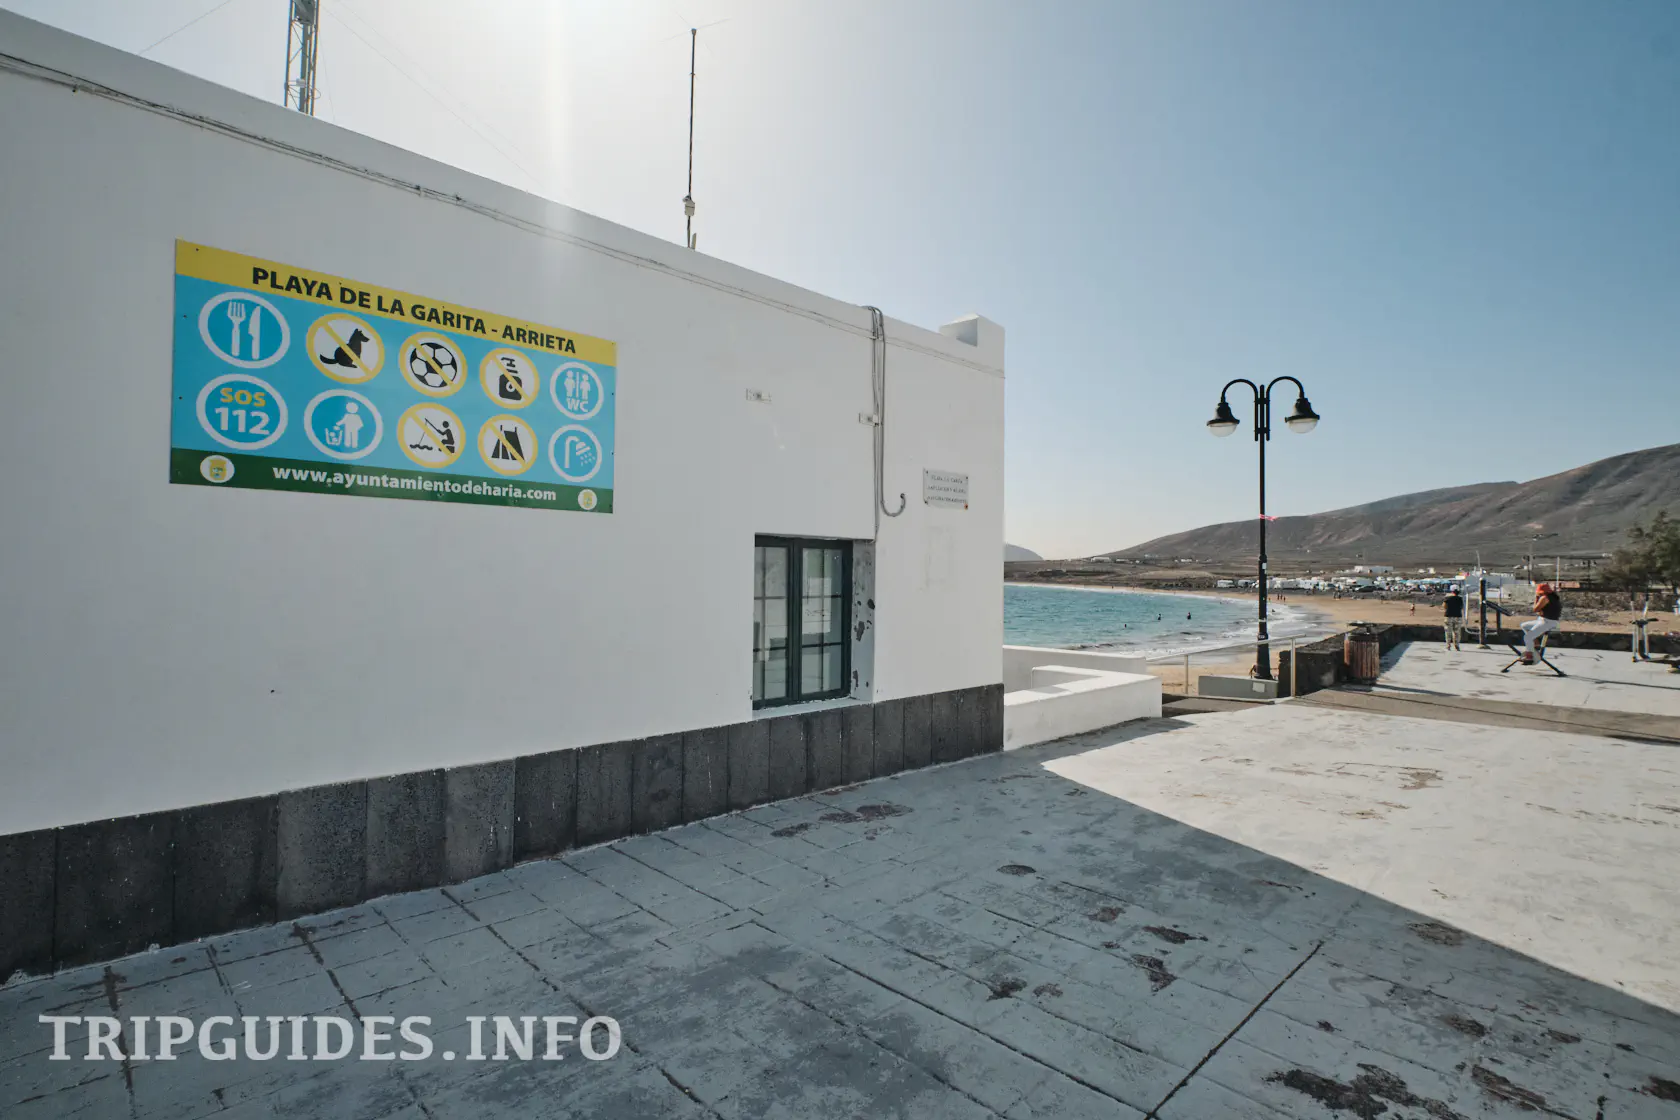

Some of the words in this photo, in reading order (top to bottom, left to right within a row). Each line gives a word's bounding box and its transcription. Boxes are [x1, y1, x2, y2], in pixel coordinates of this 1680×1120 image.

[252, 266, 333, 302] PLAYA
[339, 287, 371, 310] DE
[377, 295, 405, 317] LA
[410, 303, 486, 335] GARITA
[502, 324, 576, 354] ARRIETA
[219, 387, 266, 408] SOS
[565, 397, 589, 413] WC
[214, 407, 270, 436] 112
[273, 464, 557, 502] www.ayuntamientodeharia.com
